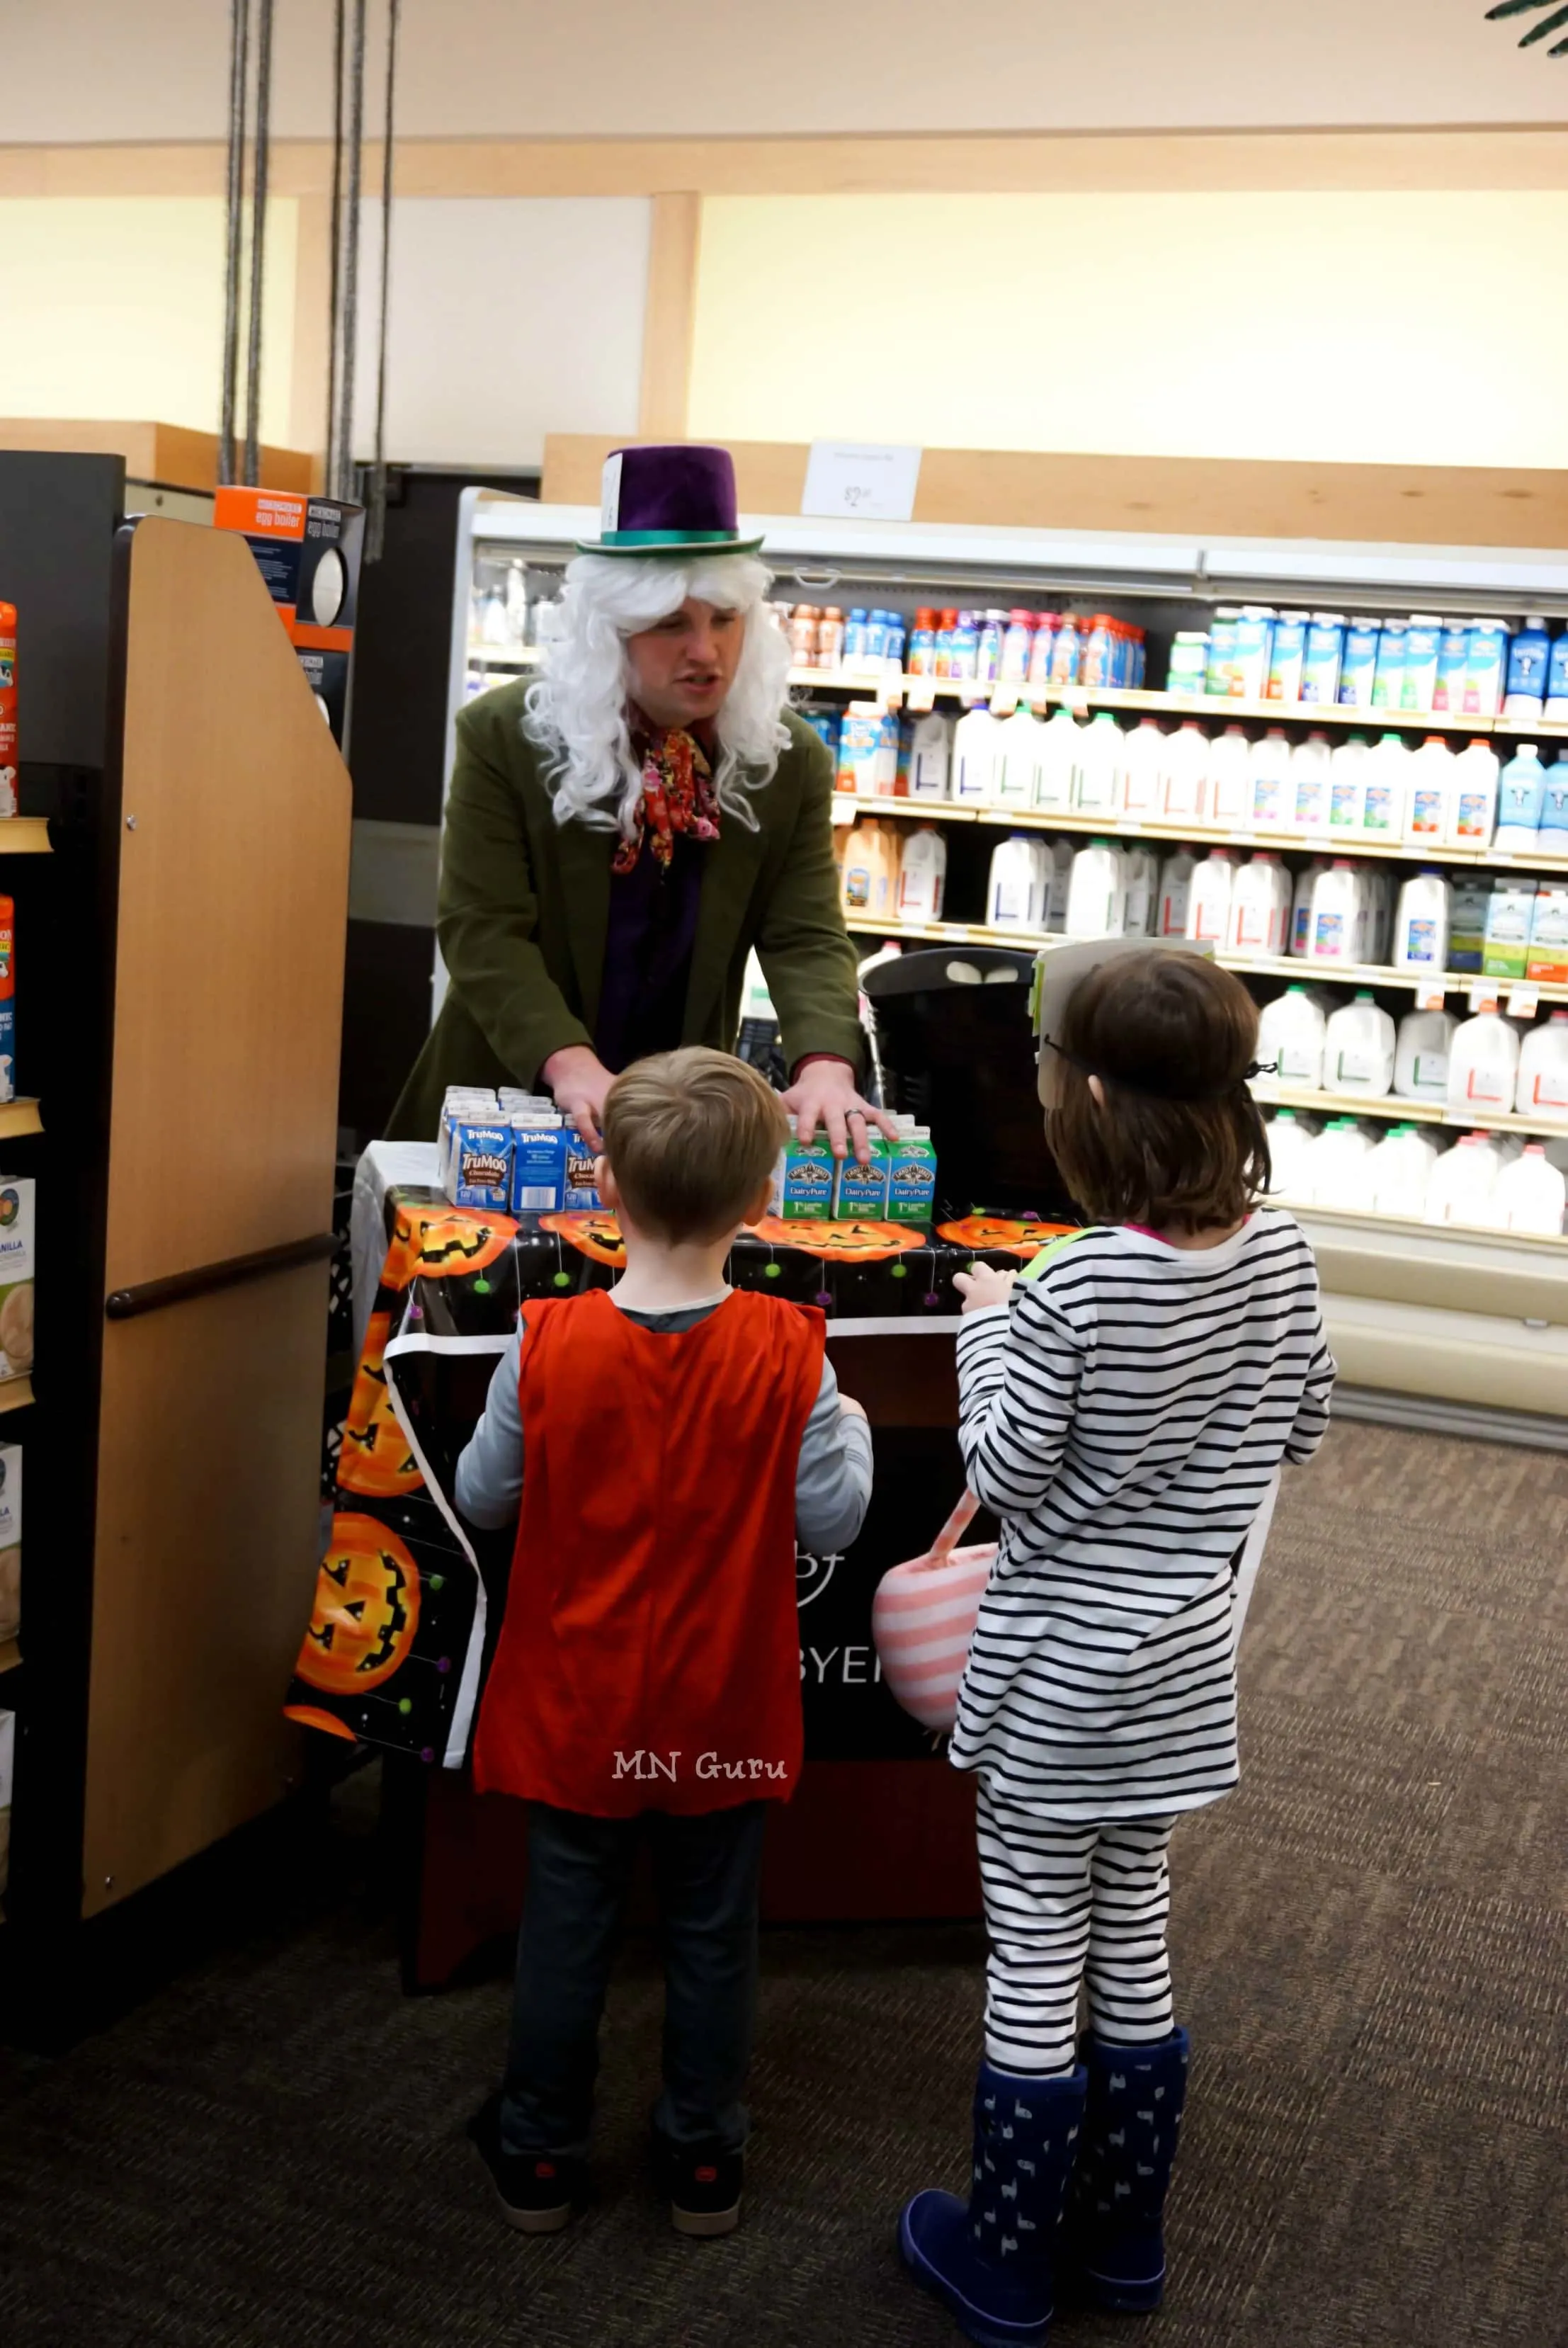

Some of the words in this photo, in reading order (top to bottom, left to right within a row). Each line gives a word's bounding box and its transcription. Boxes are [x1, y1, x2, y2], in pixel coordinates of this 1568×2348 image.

[256, 511, 273, 526] egg
[275, 511, 301, 528] boiler
[467, 1129, 504, 1142] TruMoo
[521, 1133, 558, 1144] TruMoo
[462, 1153, 506, 1172] TruMoo
[569, 1155, 596, 1173] TruM
[0, 1240, 23, 1253] NILLA
